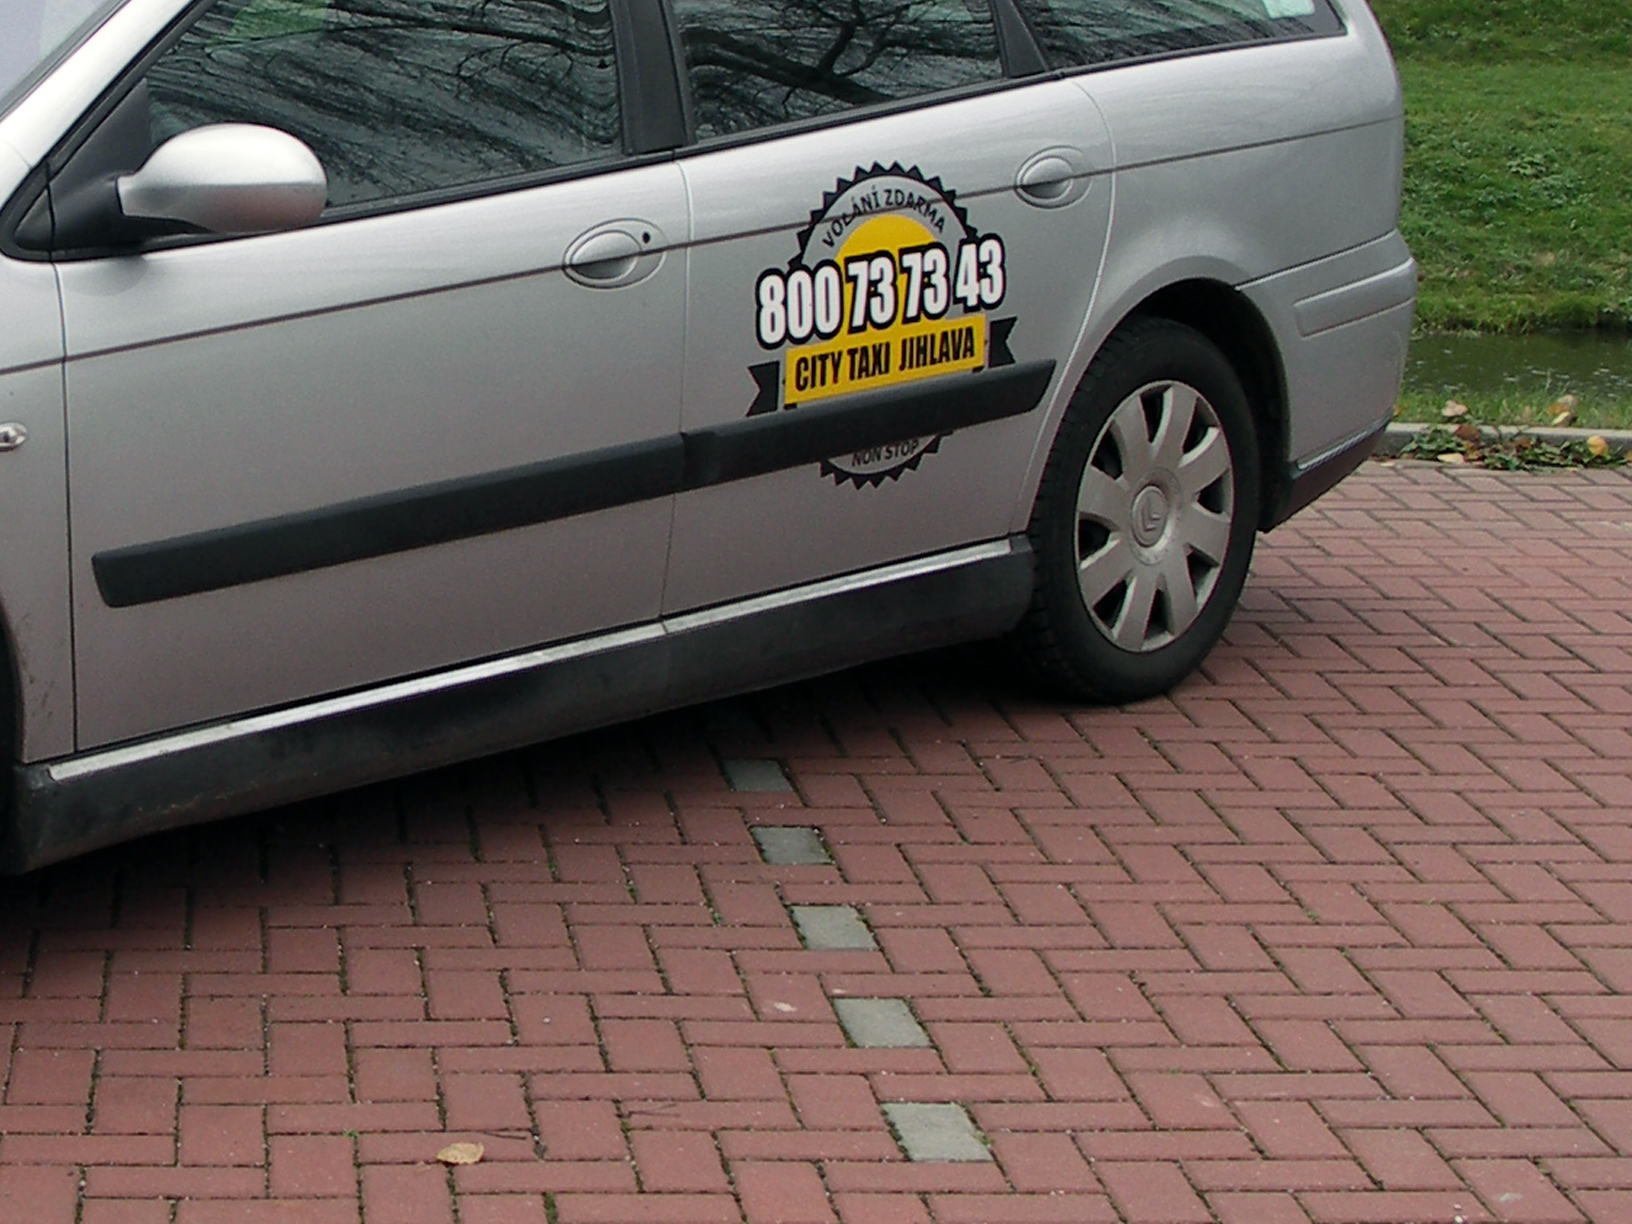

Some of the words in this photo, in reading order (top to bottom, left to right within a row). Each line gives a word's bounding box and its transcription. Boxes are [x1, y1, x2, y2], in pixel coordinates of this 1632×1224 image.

[821, 184, 880, 248] VOLÁNÍ
[883, 188, 945, 234] ZDARMA
[757, 263, 842, 346] 800
[846, 254, 896, 328] 73
[900, 246, 949, 320] 73
[953, 237, 1005, 309] 43
[795, 349, 843, 392] CITY
[847, 341, 891, 382] TAXI
[898, 325, 975, 372] JIHLAVA
[851, 446, 882, 467] NON
[884, 437, 919, 460] STOP
